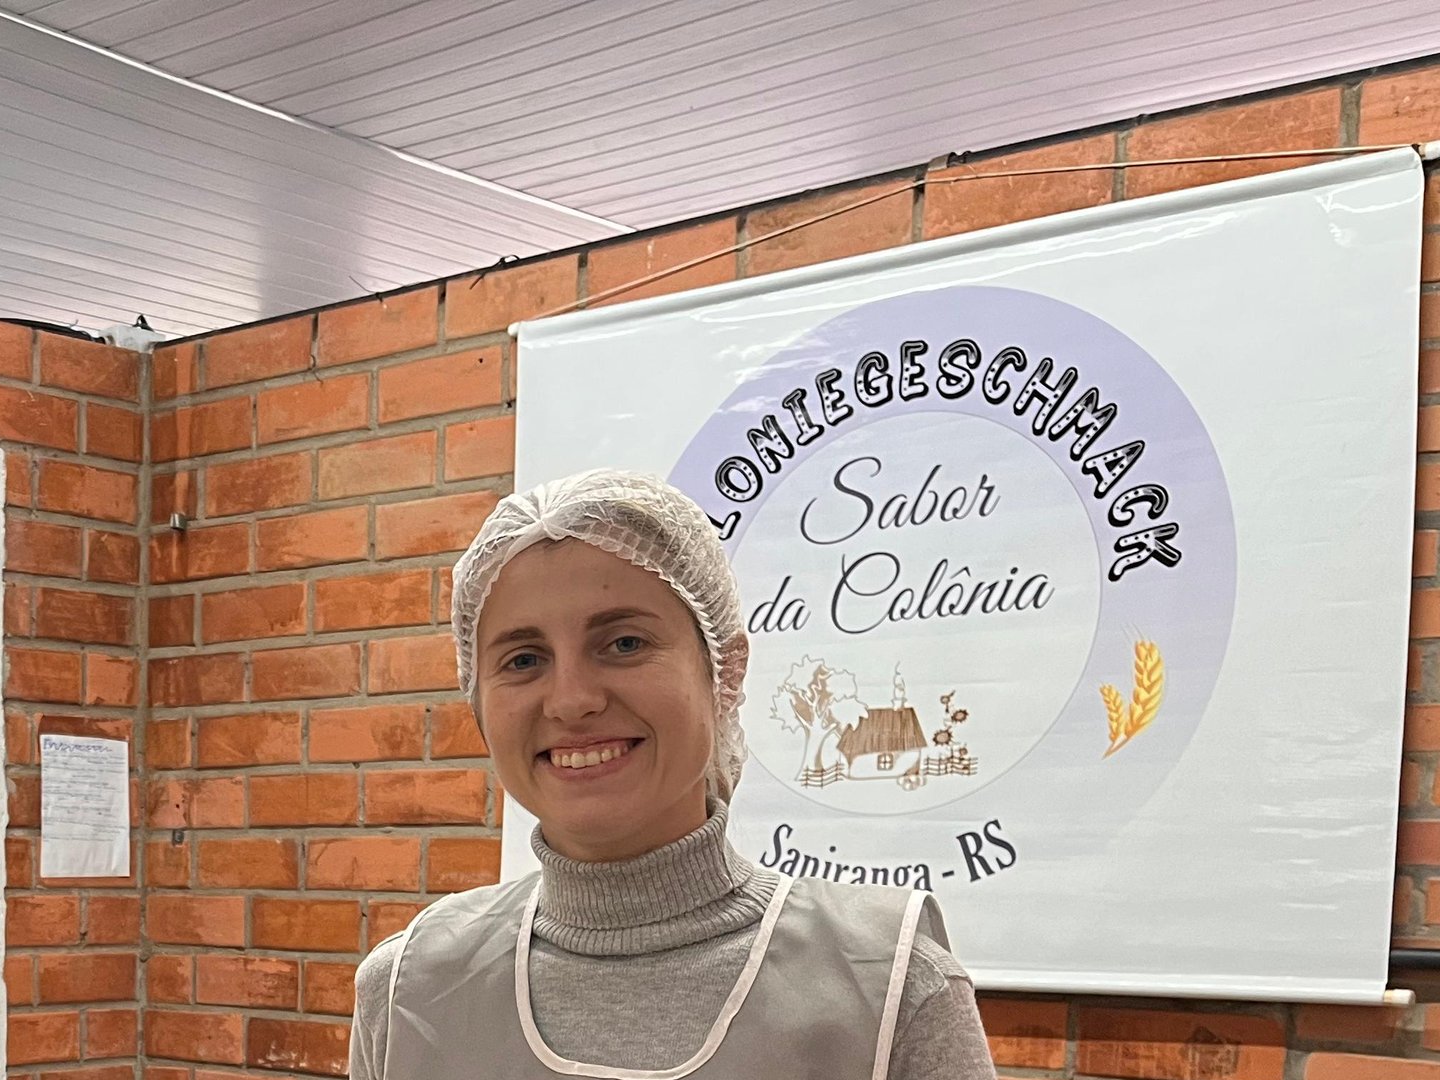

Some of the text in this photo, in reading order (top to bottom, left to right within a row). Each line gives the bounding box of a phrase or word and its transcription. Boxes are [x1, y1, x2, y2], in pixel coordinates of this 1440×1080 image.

[800, 456, 1001, 545] Sabor
[748, 551, 1056, 634] da Colônia
[956, 819, 1017, 883] RS
